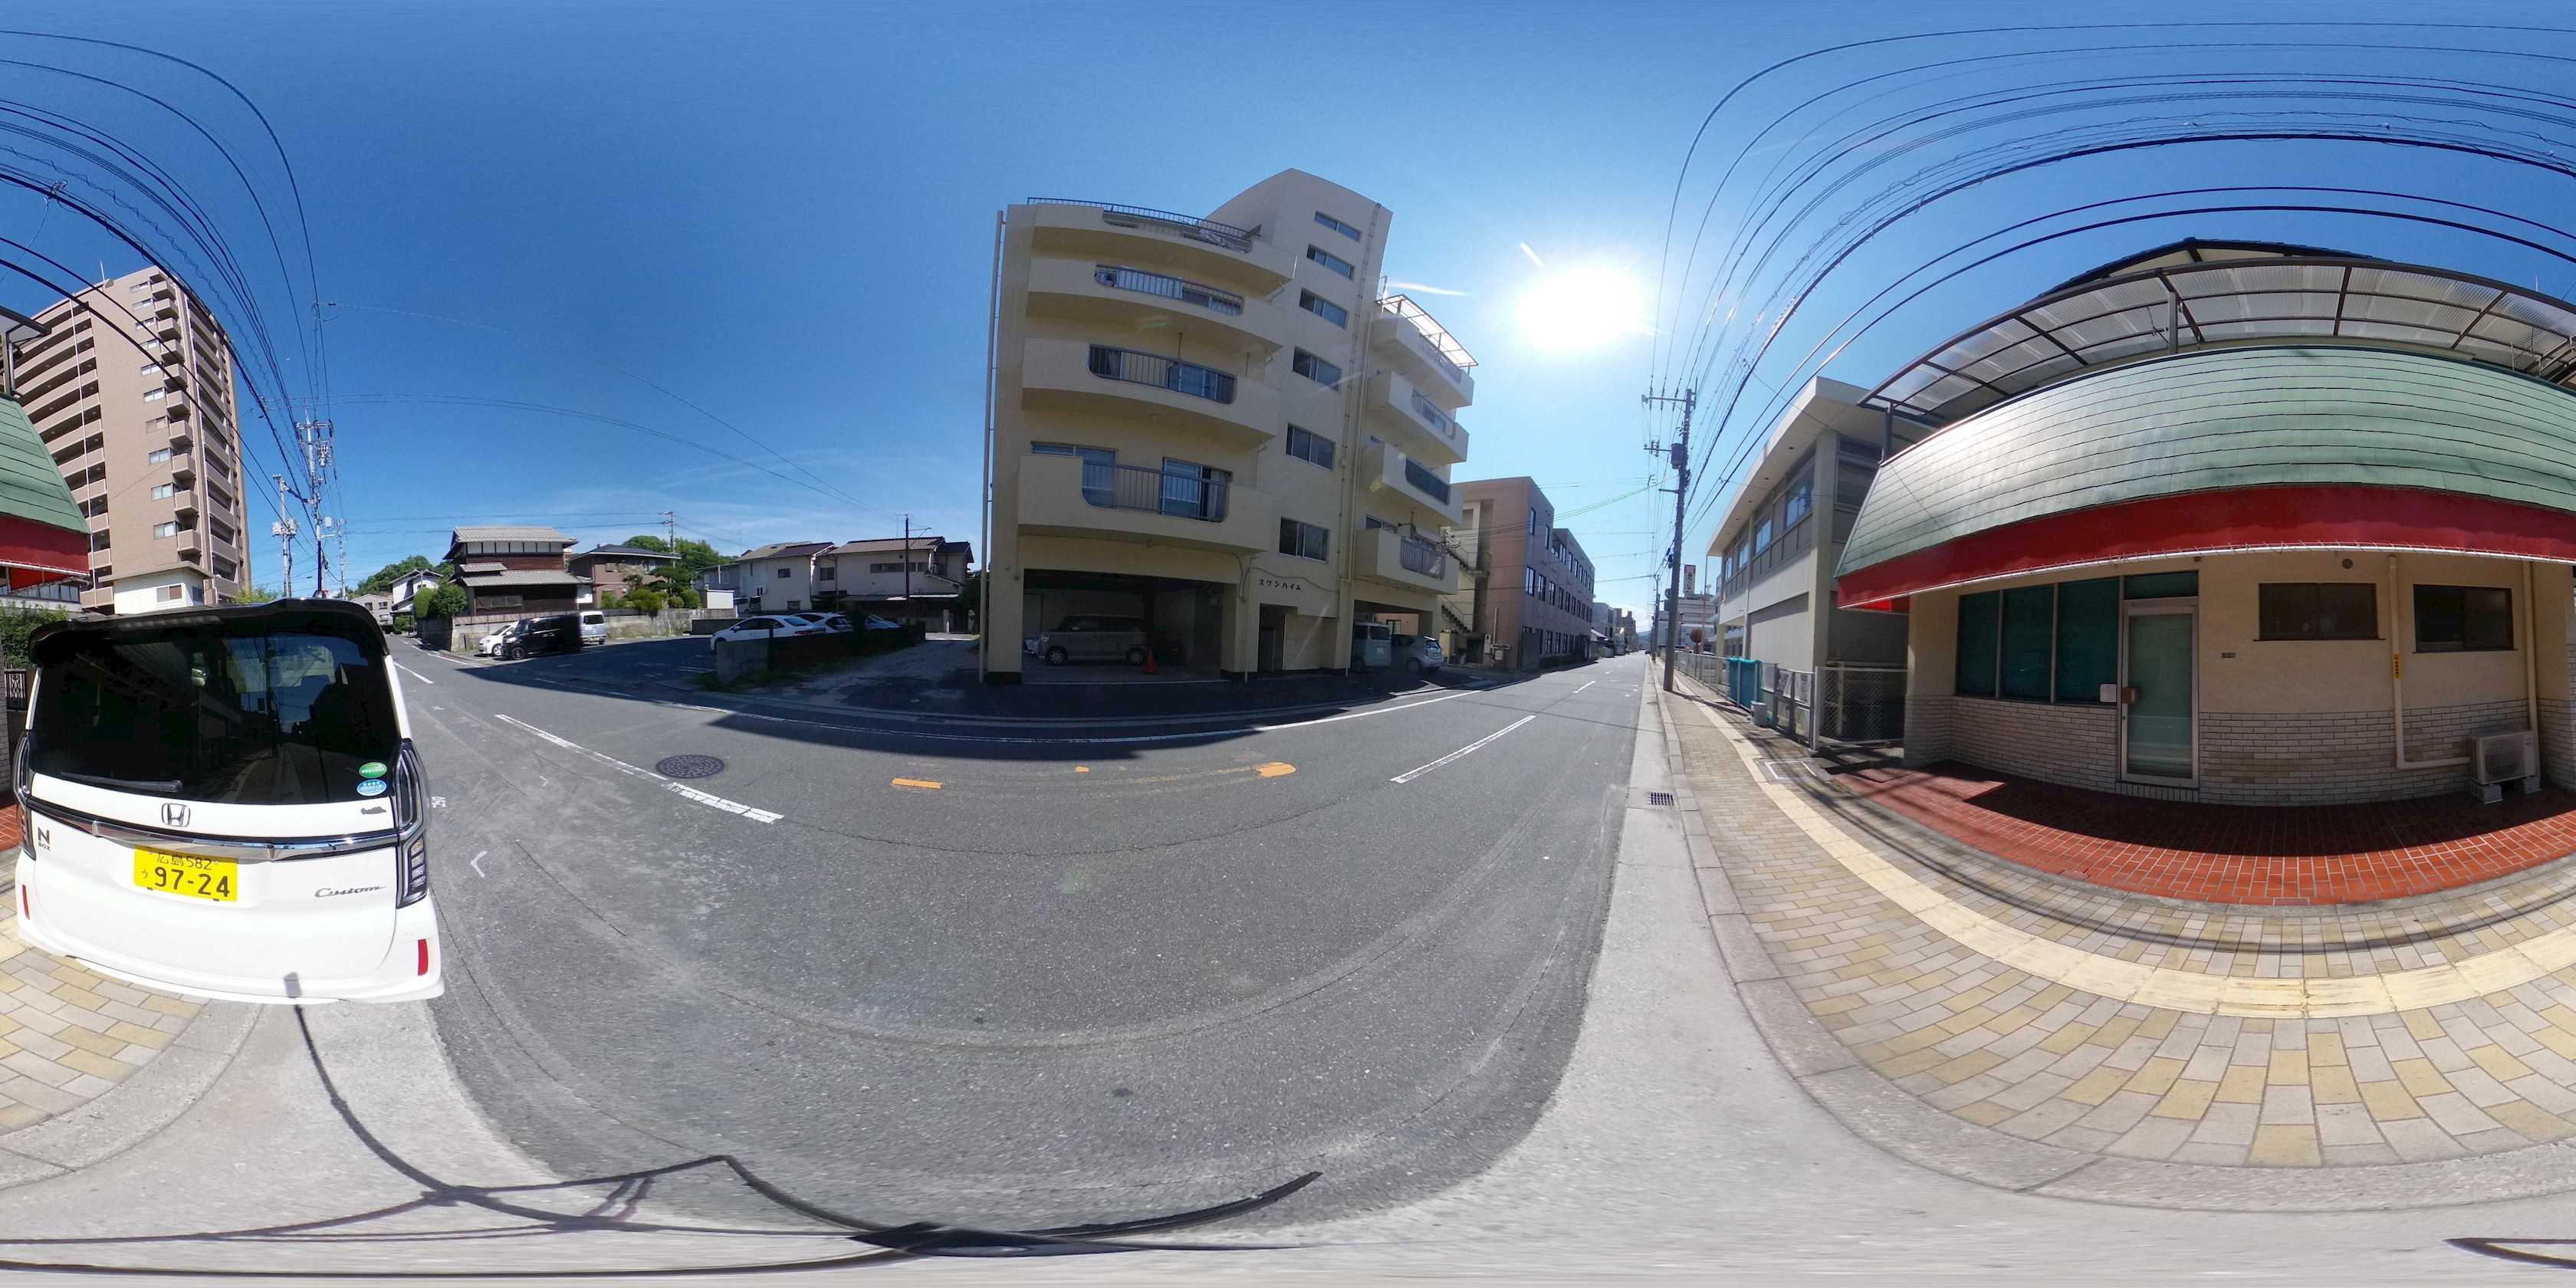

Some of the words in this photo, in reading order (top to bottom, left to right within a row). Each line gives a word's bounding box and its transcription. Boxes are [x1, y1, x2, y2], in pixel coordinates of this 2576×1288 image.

[1259, 579, 1301, 590] スワンハイム
[38, 827, 50, 845] N
[154, 866, 230, 897] 97-24
[314, 886, 386, 898] Custom
